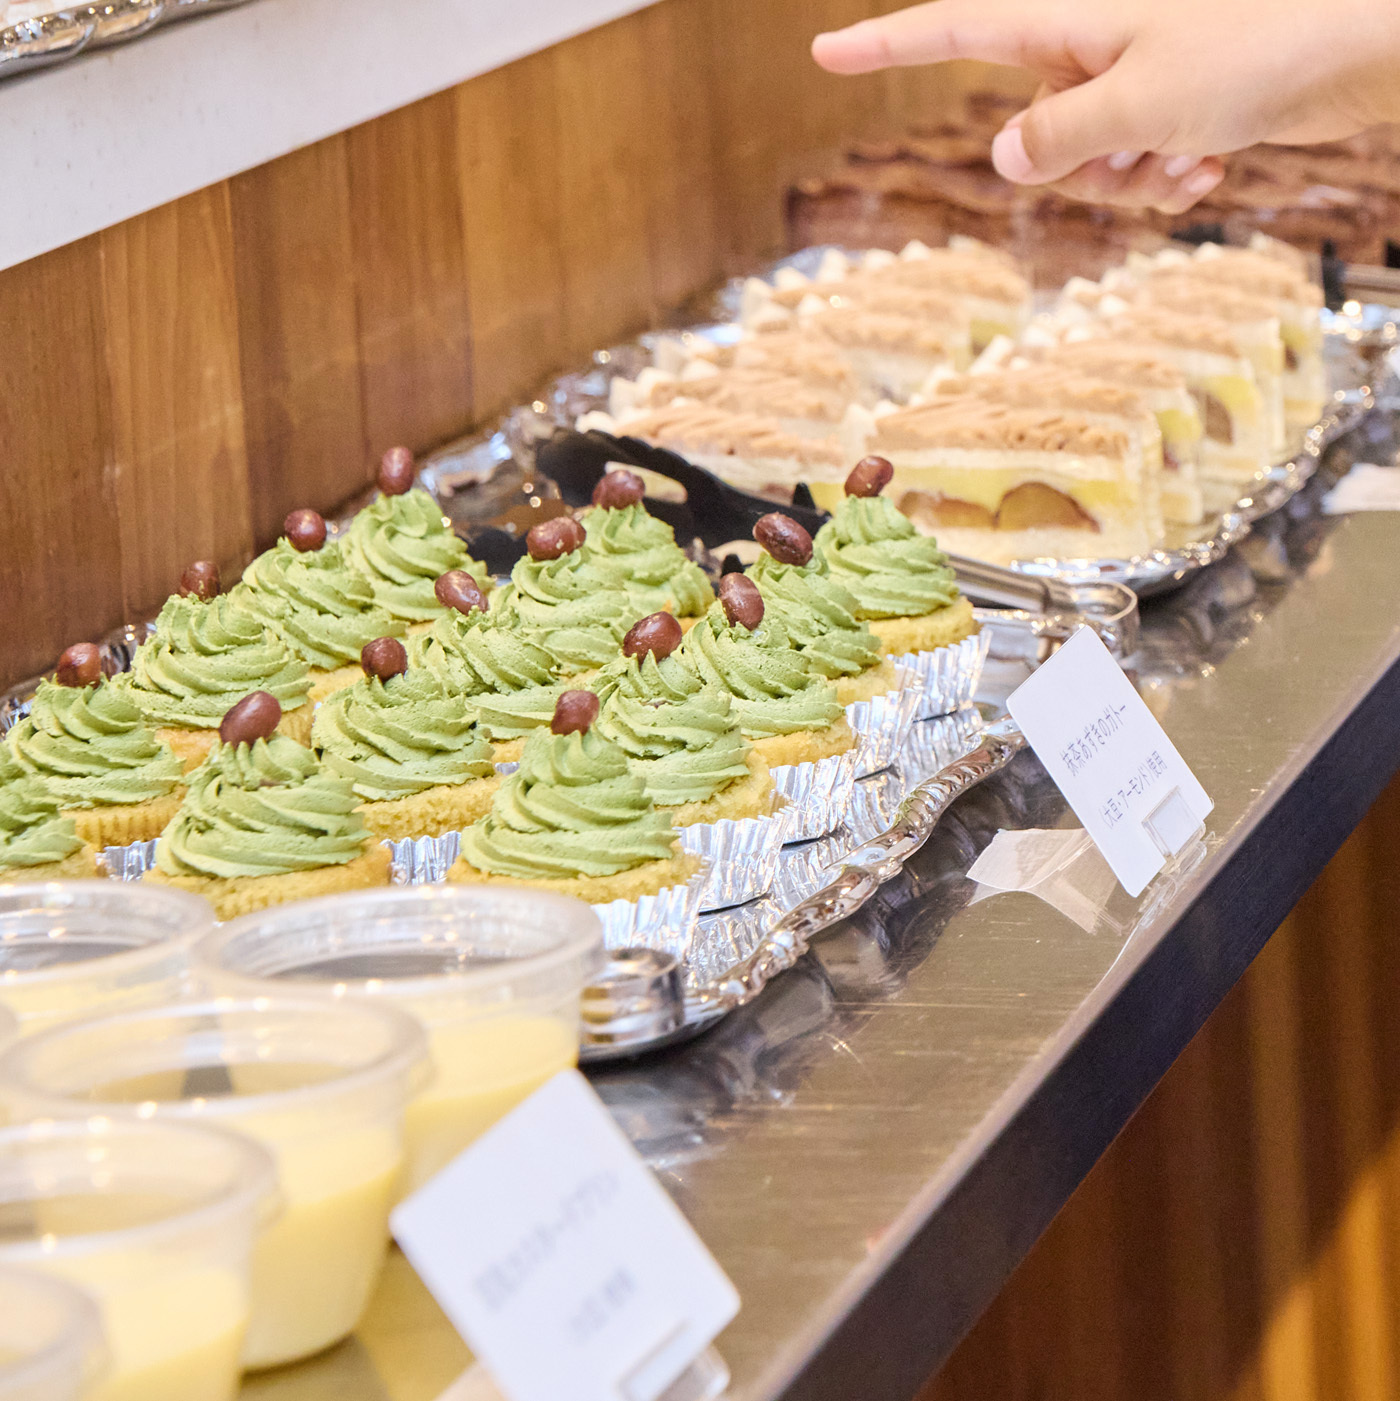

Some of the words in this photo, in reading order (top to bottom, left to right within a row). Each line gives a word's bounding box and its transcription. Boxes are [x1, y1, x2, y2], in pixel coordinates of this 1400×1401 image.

[1060, 703, 1126, 776] 抹茶あずきのガトー
